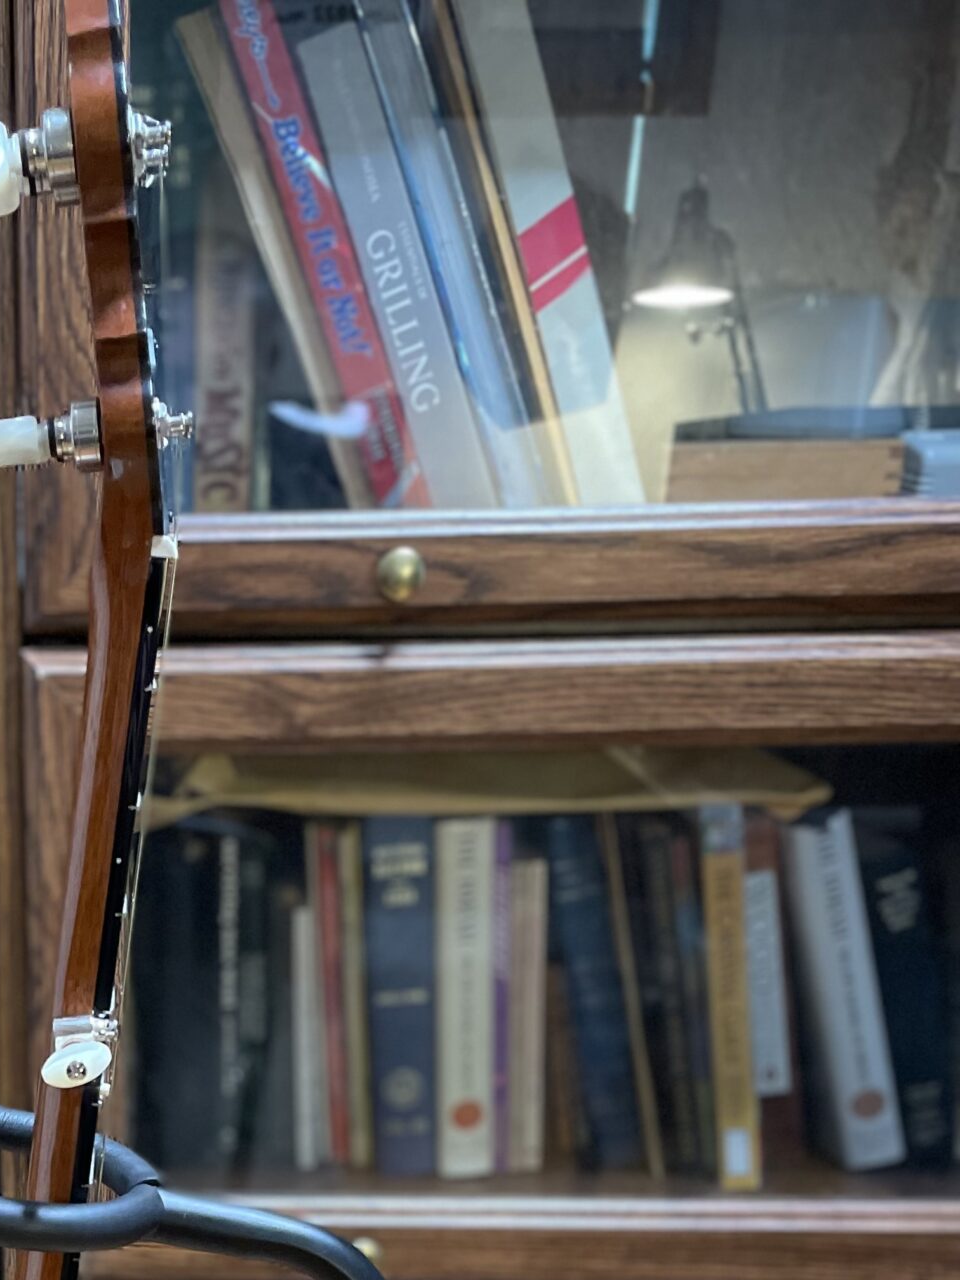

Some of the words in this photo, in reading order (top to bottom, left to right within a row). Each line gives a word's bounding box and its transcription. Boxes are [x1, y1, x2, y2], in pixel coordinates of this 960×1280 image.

[272, 116, 321, 223] Believe
[305, 227, 337, 256] It
[317, 258, 344, 290] or
[327, 294, 374, 358] Not!
[366, 229, 440, 413] GRILLING
